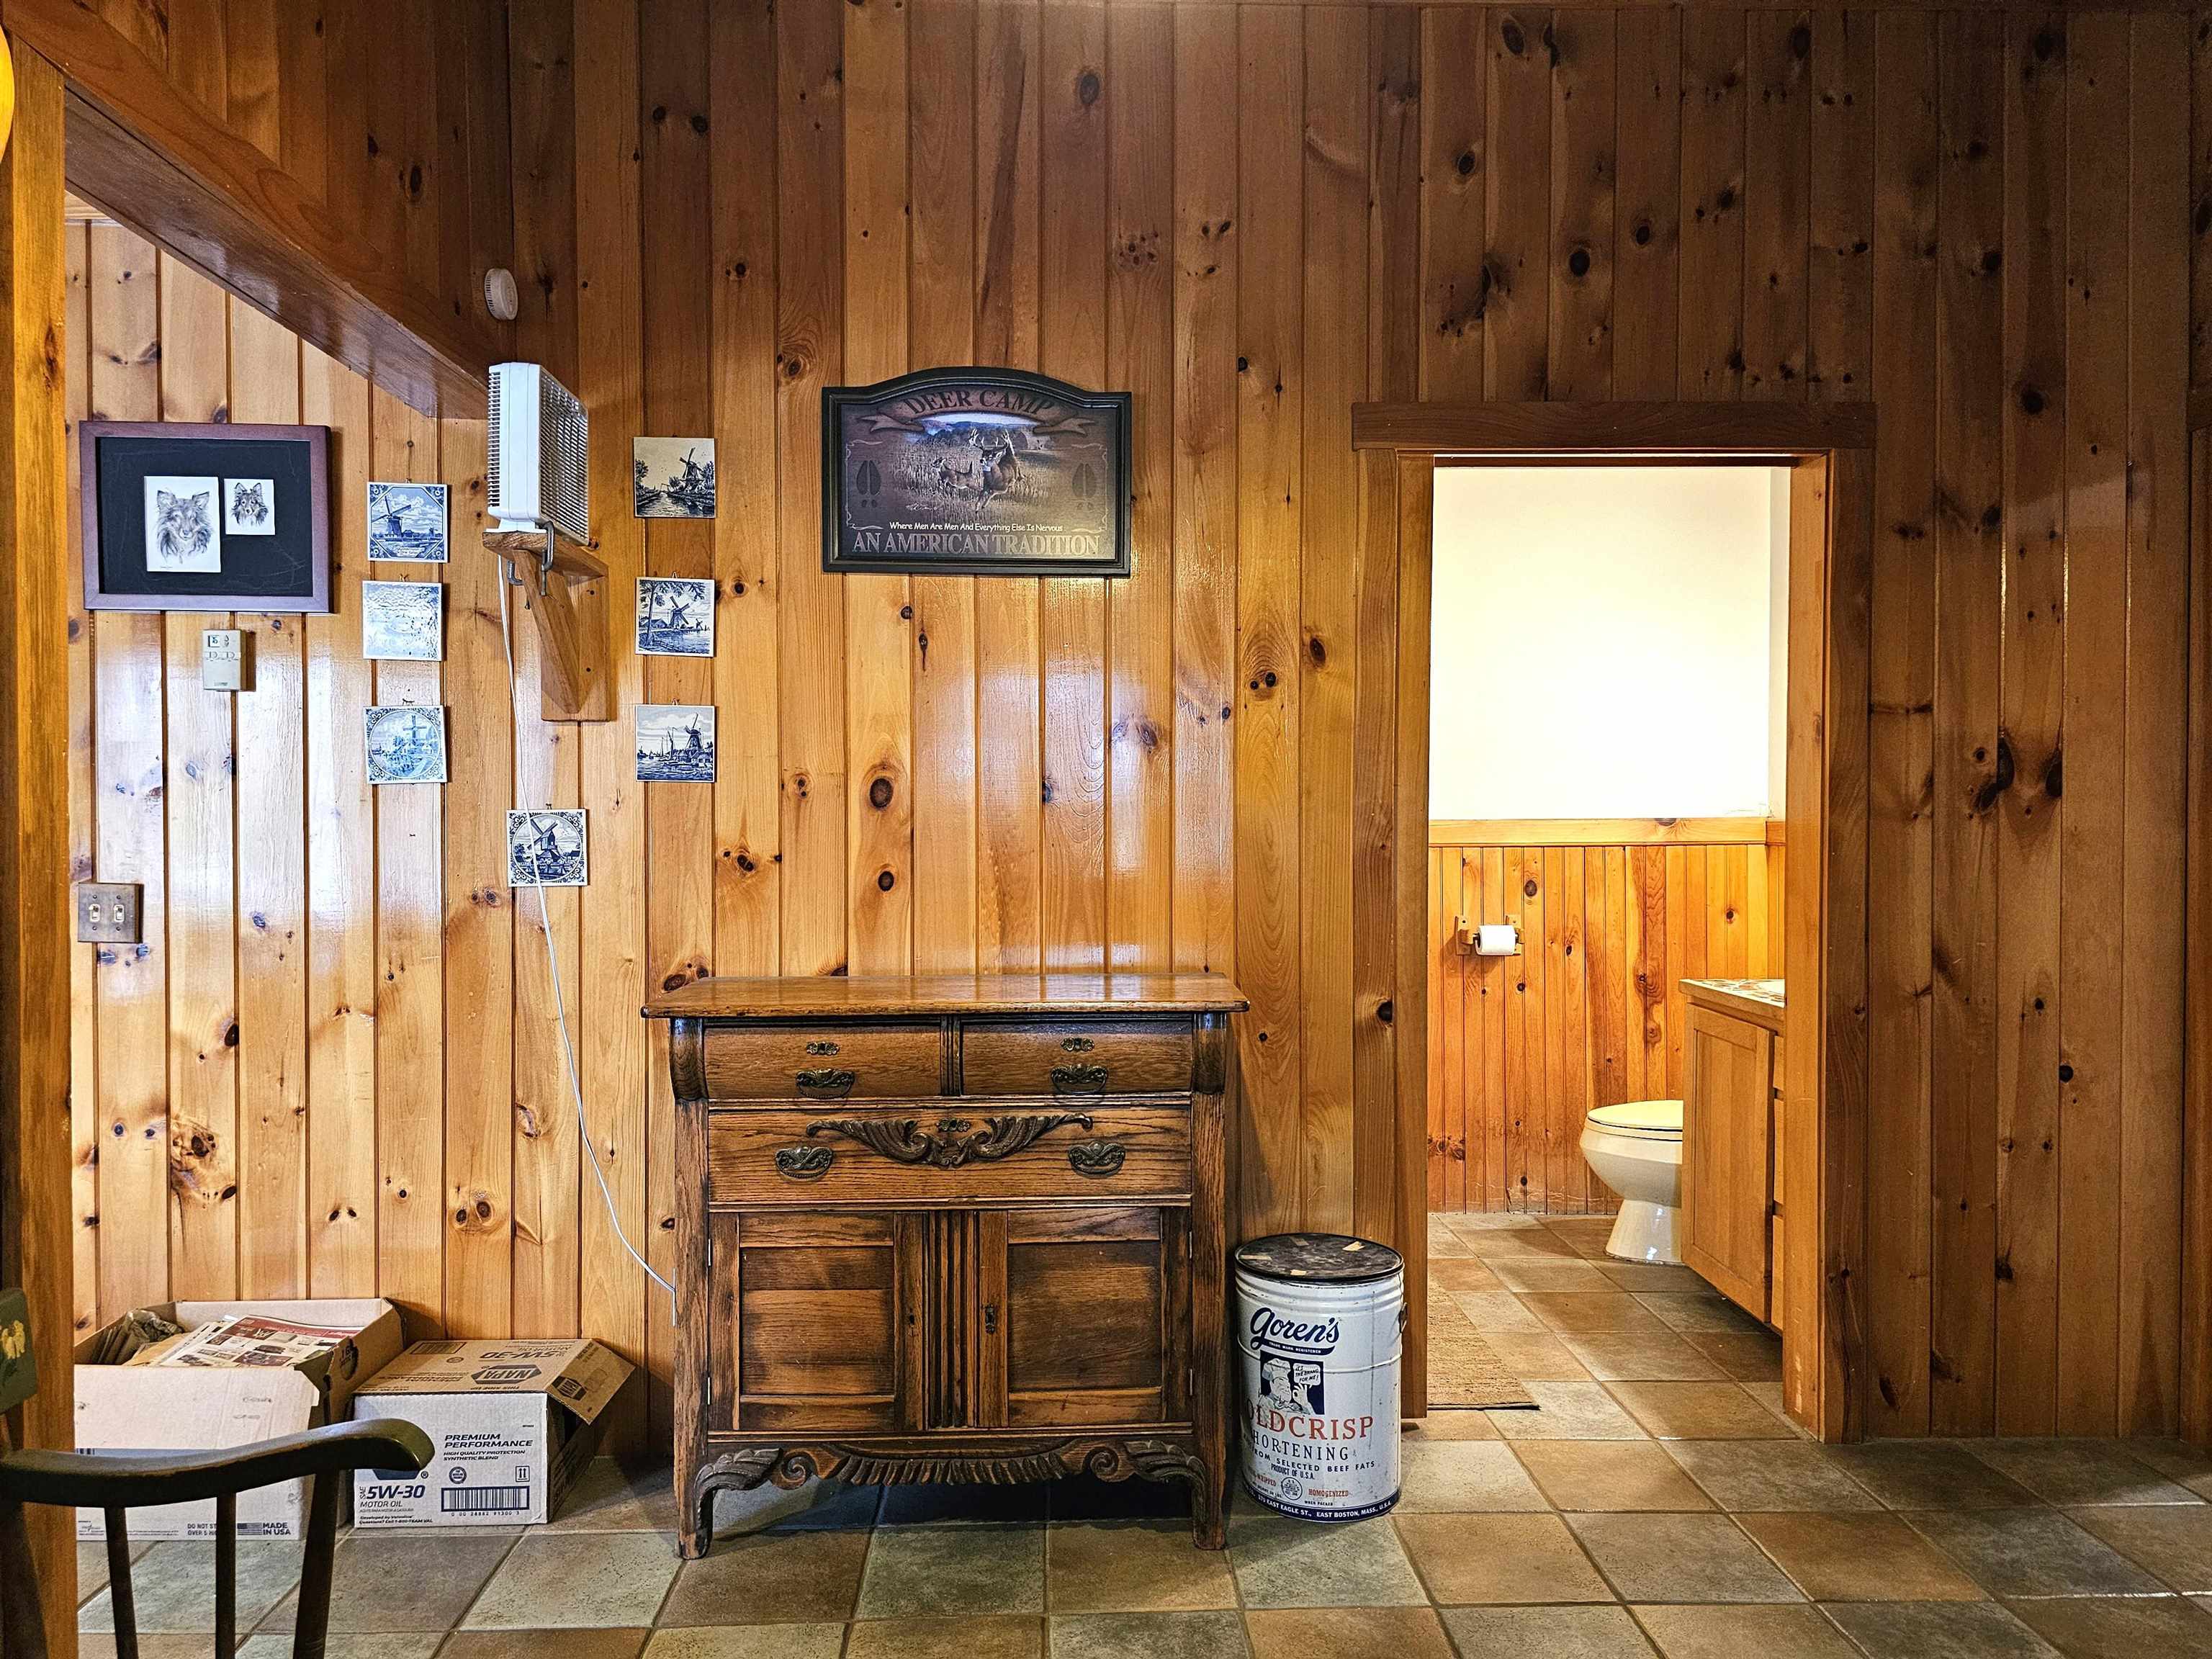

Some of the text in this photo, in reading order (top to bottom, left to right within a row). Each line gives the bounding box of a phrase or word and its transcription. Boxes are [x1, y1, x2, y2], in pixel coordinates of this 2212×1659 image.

[903, 390, 1053, 415] DEER CAMP
[889, 521, 913, 530] Where
[975, 523, 1010, 533] Everything
[852, 531, 1100, 557] AN AMERICAN TRADITION
[483, 1370, 531, 1380] NAPA
[444, 1439, 534, 1449] PERFORMANCE
[1271, 1462, 1290, 1475] PRODUCT
[1276, 1457, 1320, 1472] SELECTED
[1355, 1460, 1375, 1470] FATS
[367, 1485, 426, 1499] 5W-30
[1308, 1488, 1349, 1498] HOMOGENIZED
[1267, 1499, 1280, 1508] EAST
[1280, 1505, 1299, 1514] EAGLE
